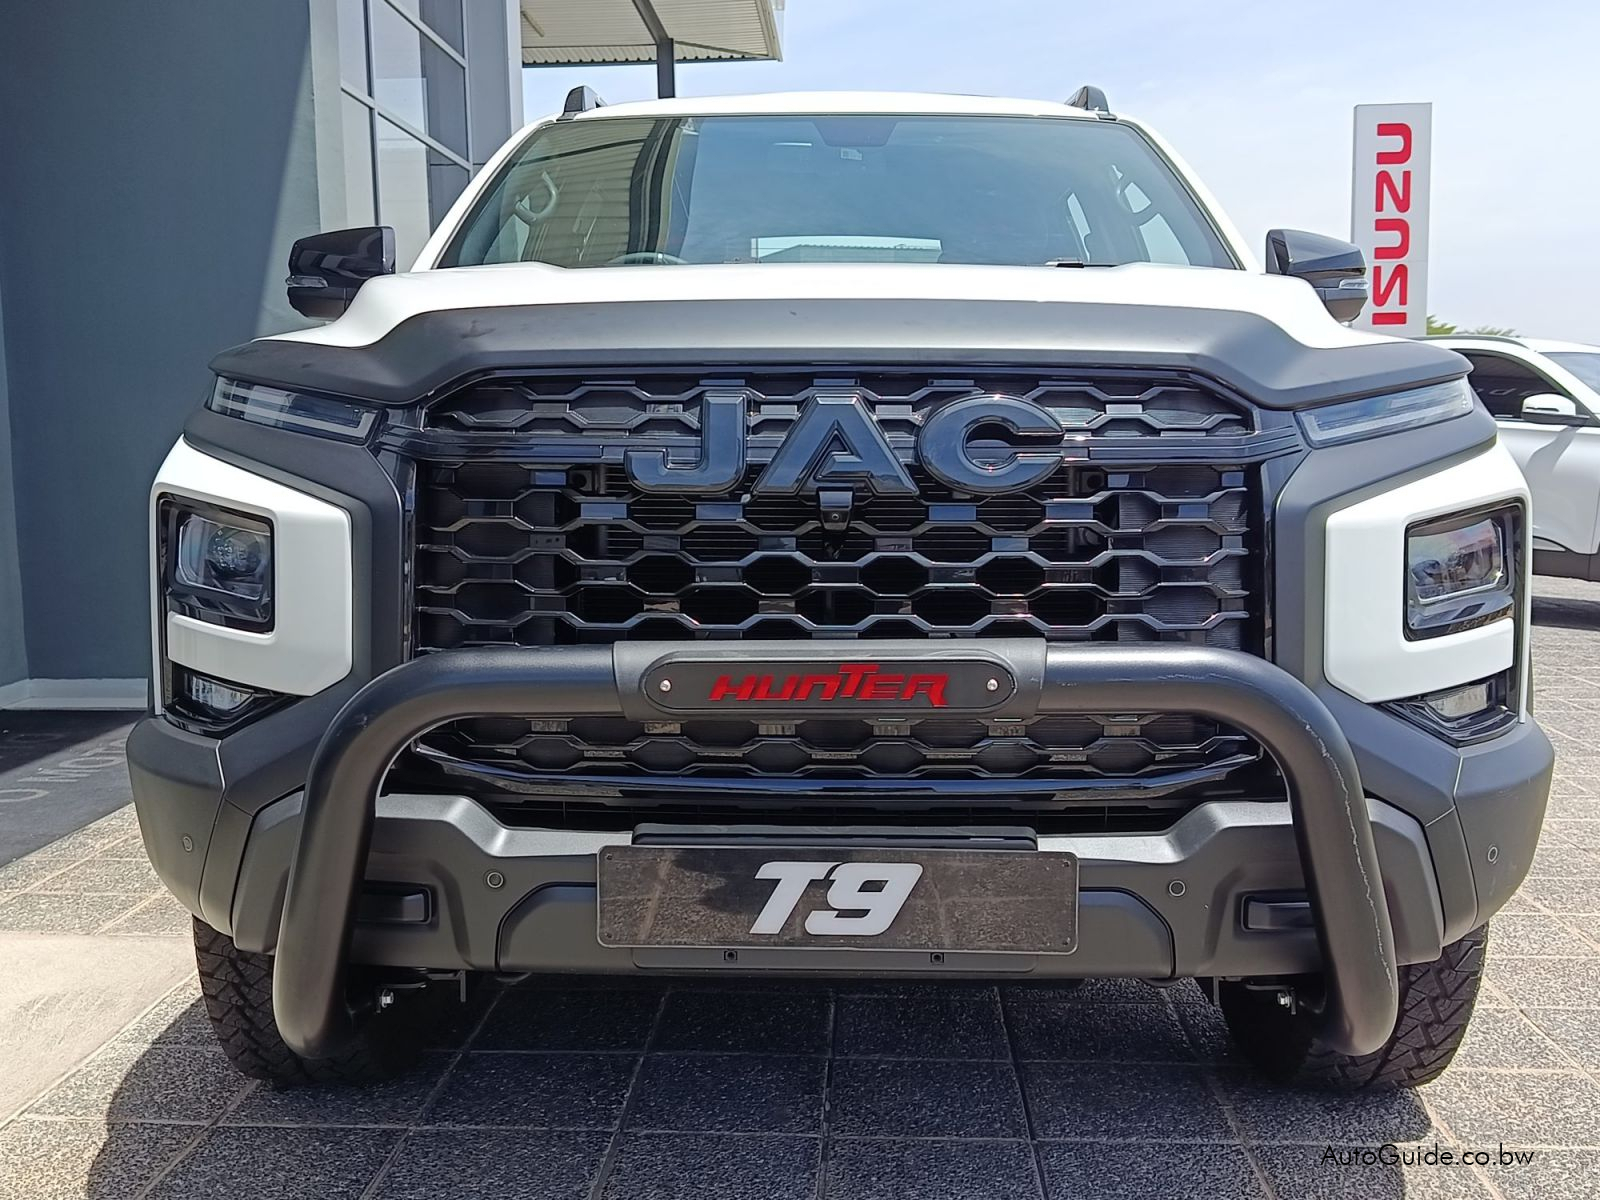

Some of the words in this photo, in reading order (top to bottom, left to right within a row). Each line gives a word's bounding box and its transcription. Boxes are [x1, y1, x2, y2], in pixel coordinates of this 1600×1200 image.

[1371, 122, 1412, 326] ISUZU
[623, 391, 1066, 497] JAC
[708, 662, 949, 707] HUNTER
[749, 861, 923, 936] T9
